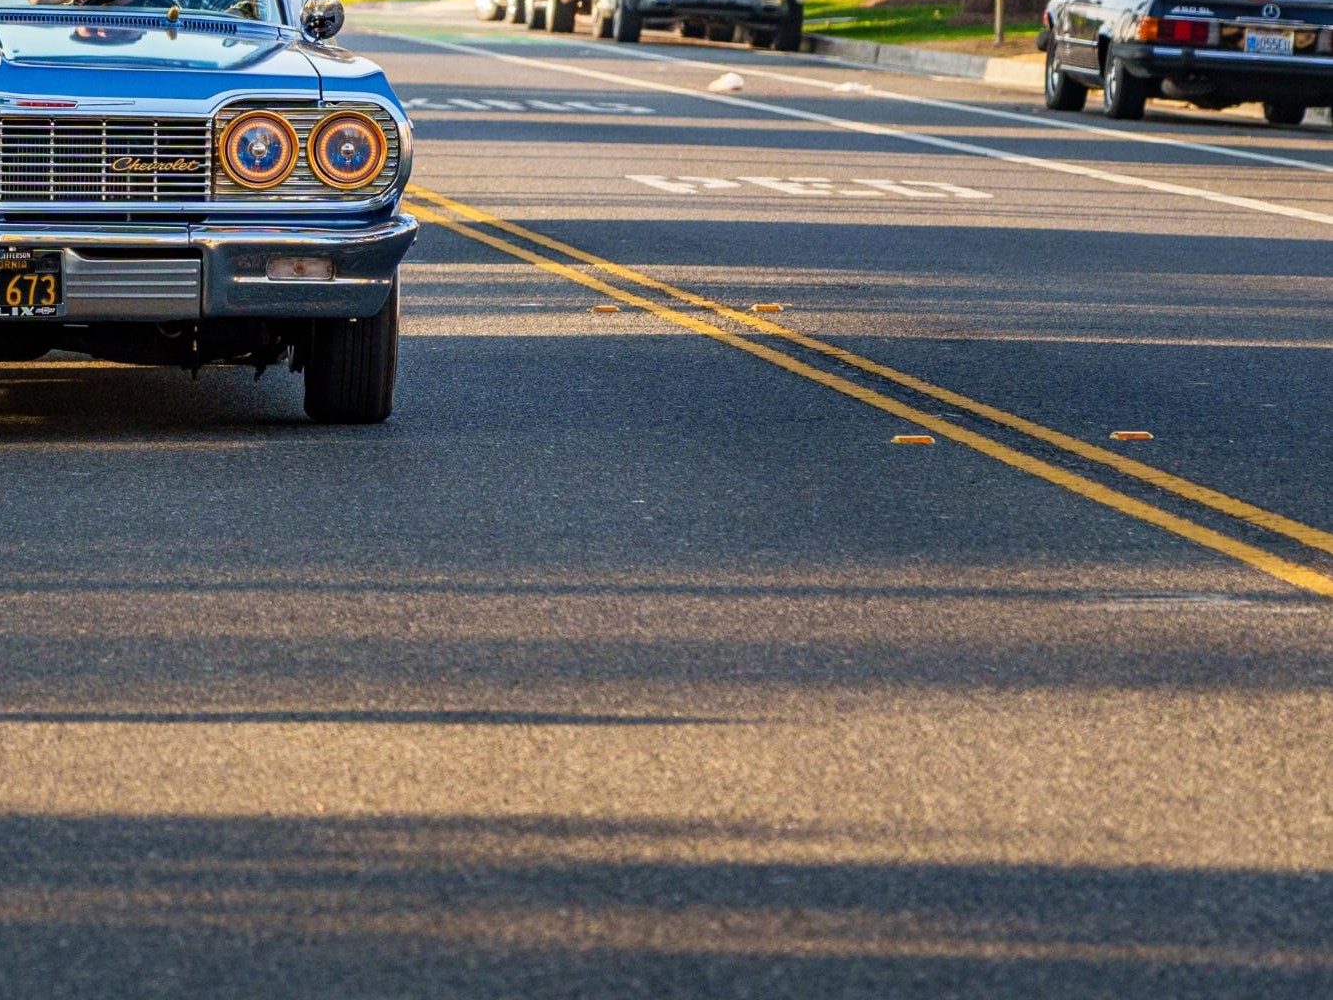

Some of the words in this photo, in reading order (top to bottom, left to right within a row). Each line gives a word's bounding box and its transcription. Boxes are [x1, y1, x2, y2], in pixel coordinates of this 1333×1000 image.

[111, 157, 200, 171] Chevrolet
[624, 174, 994, 199] PED
[5, 274, 56, 306] 673
